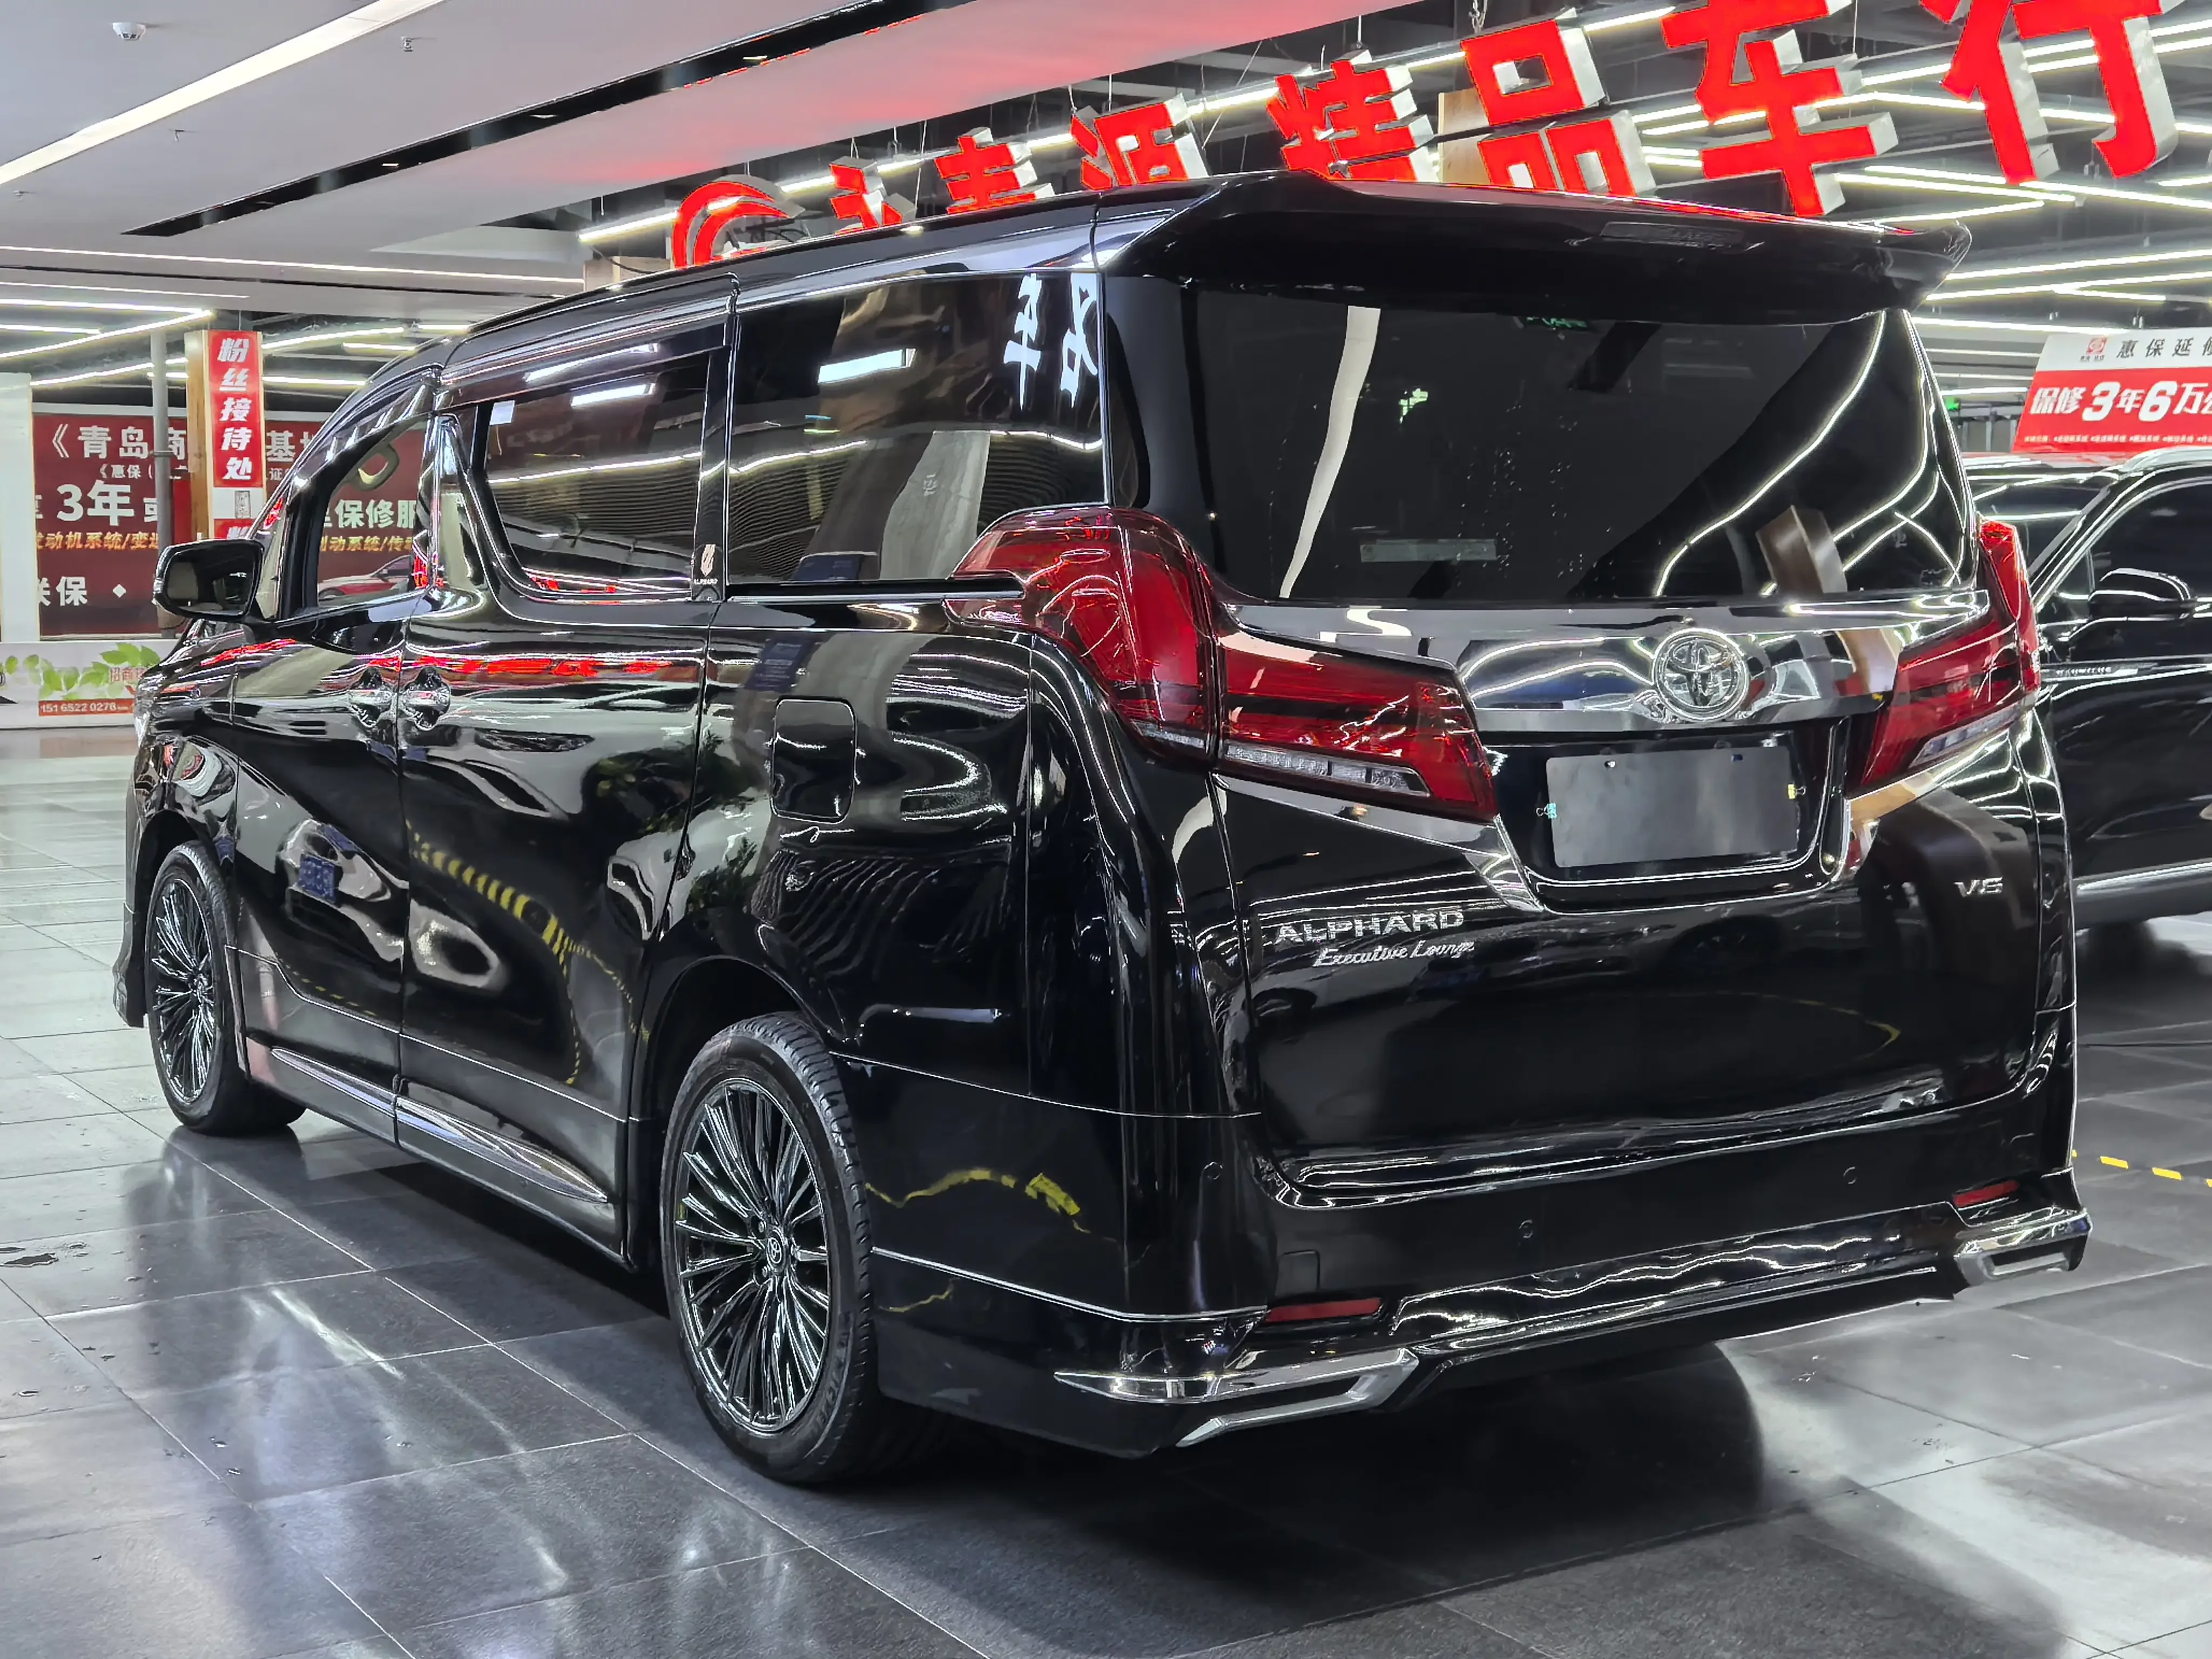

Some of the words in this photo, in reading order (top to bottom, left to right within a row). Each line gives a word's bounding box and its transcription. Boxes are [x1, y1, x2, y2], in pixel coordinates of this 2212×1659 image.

[217, 337, 252, 481] 粉丝接待处
[1274, 910, 1465, 946] ALPHARD
[1312, 945, 1408, 967] Executive
[1410, 940, 1475, 959] Lounge
